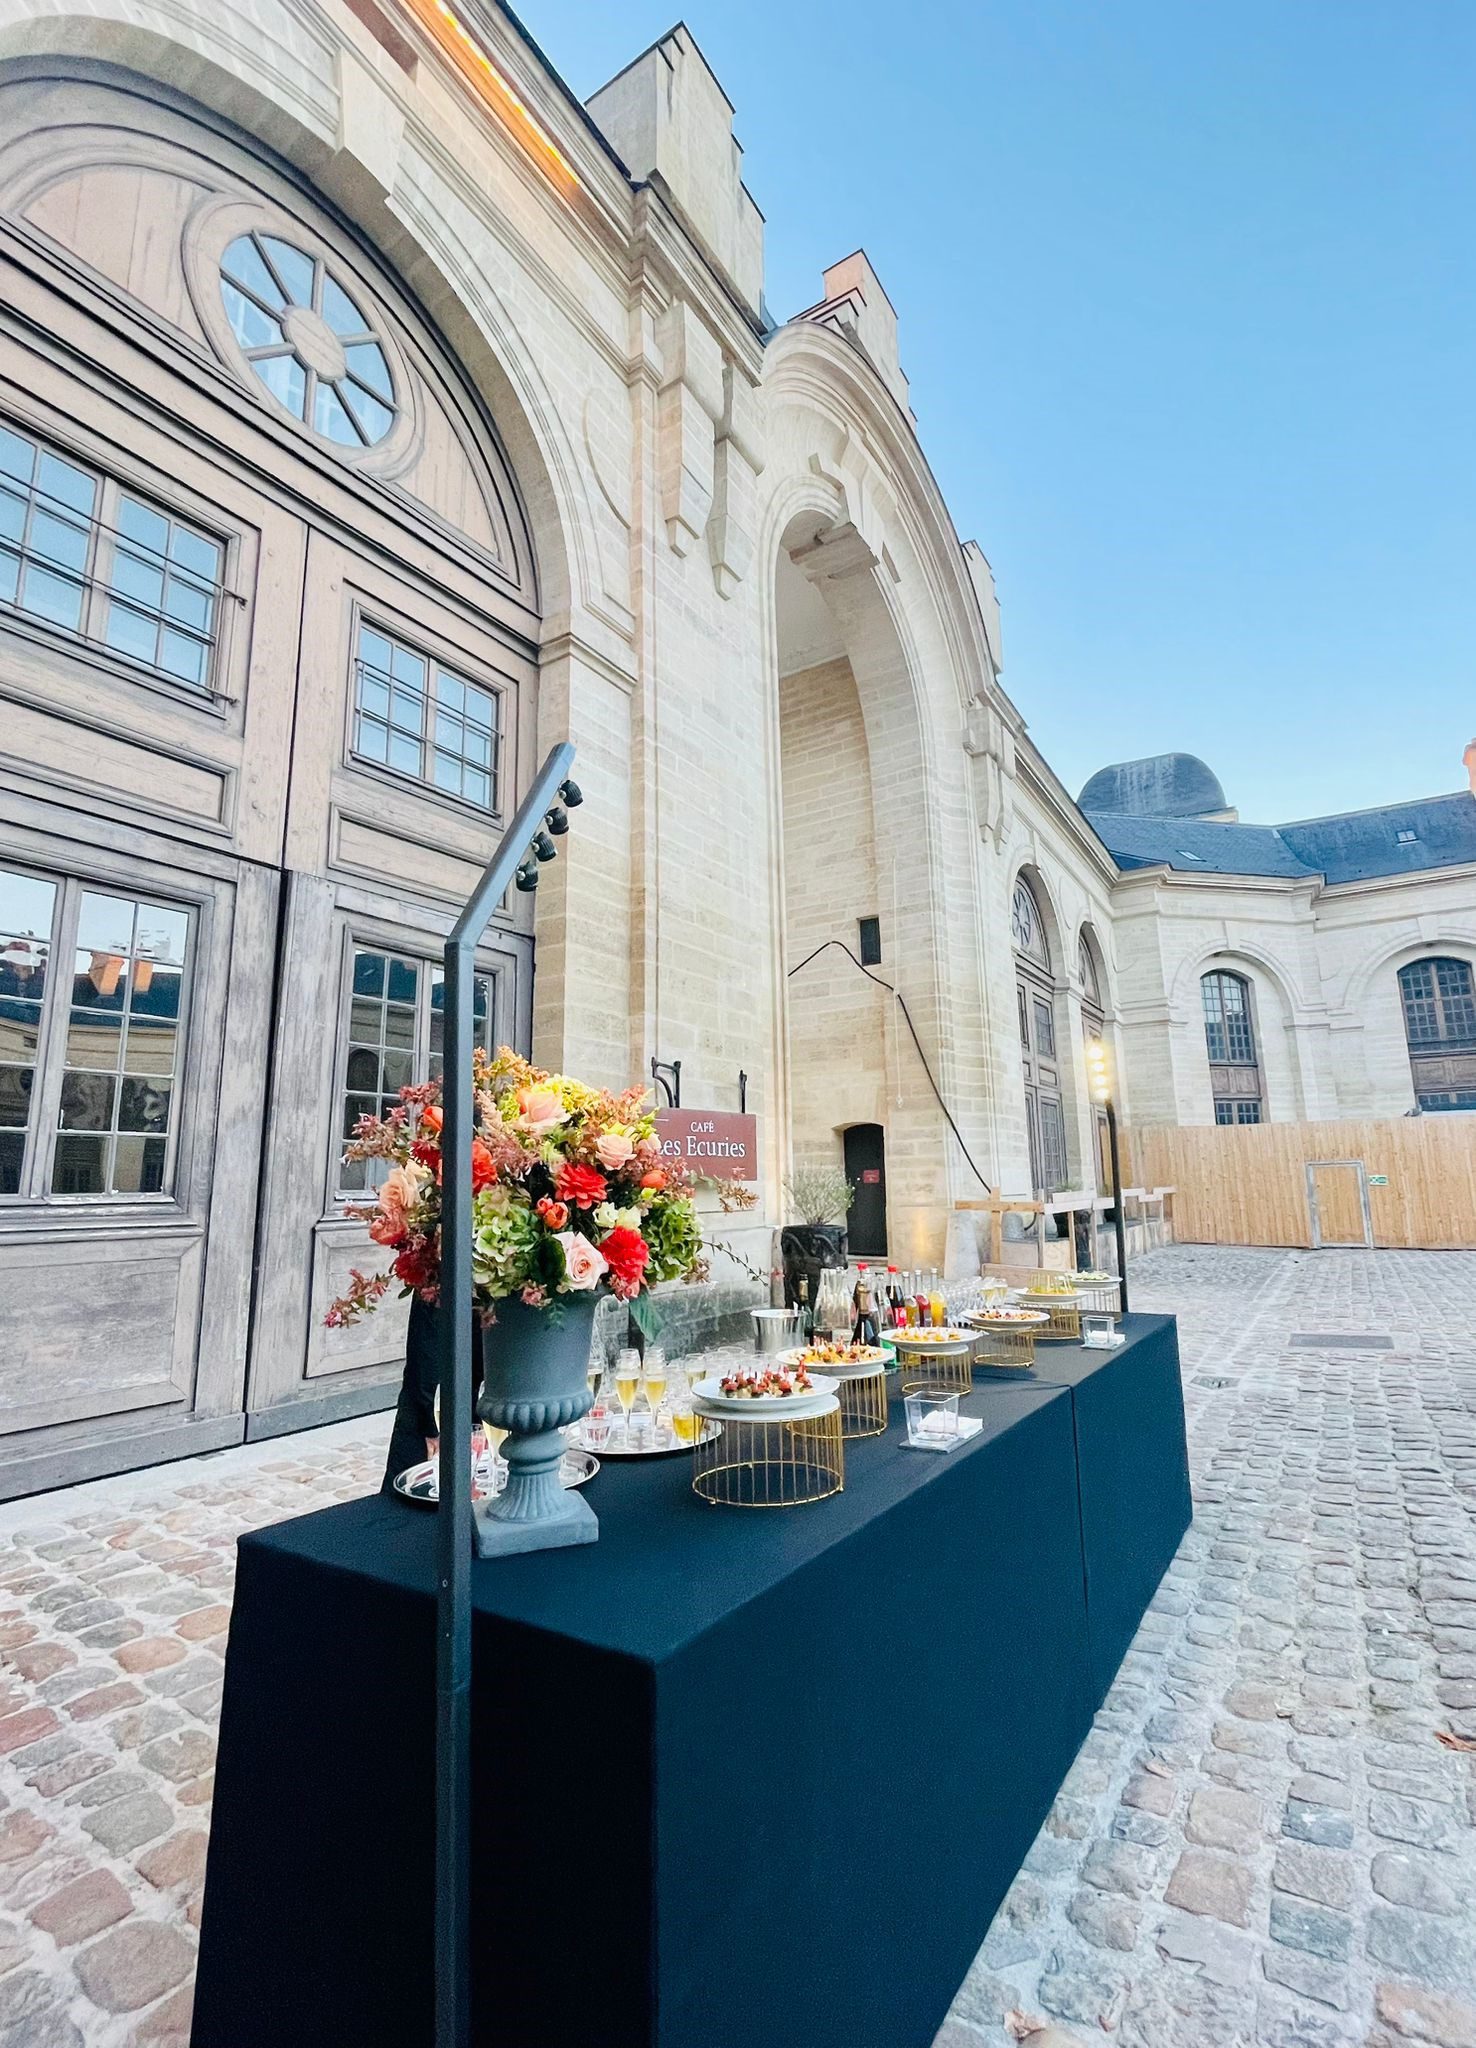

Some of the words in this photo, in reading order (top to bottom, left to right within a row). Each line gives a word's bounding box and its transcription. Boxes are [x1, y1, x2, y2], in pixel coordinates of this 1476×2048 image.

[690, 1120, 715, 1133] CAFÉ
[659, 1139, 682, 1156] es
[686, 1135, 746, 1157] Ecuries
